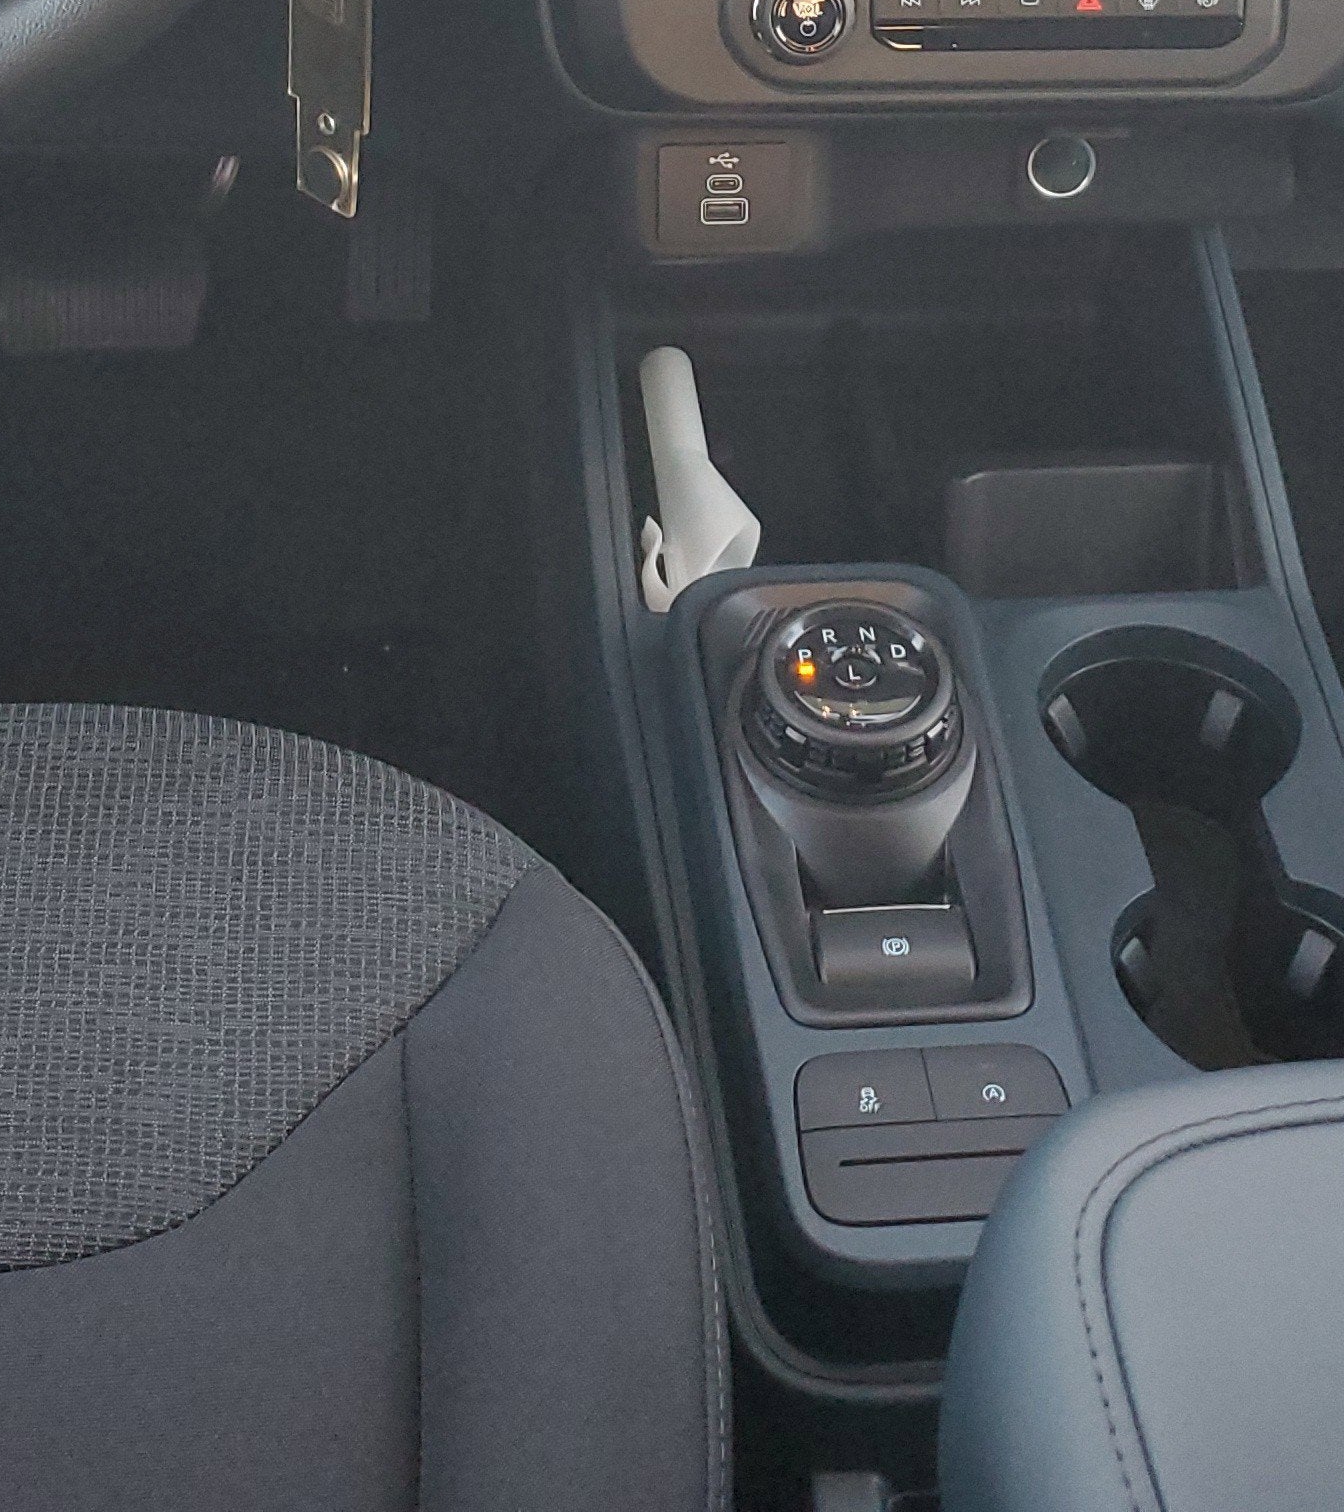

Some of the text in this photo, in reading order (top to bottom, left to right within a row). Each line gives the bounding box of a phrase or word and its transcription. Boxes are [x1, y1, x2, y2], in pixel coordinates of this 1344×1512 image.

[822, 626, 876, 643] R N
[797, 644, 907, 663] P D
[848, 665, 861, 680] L
